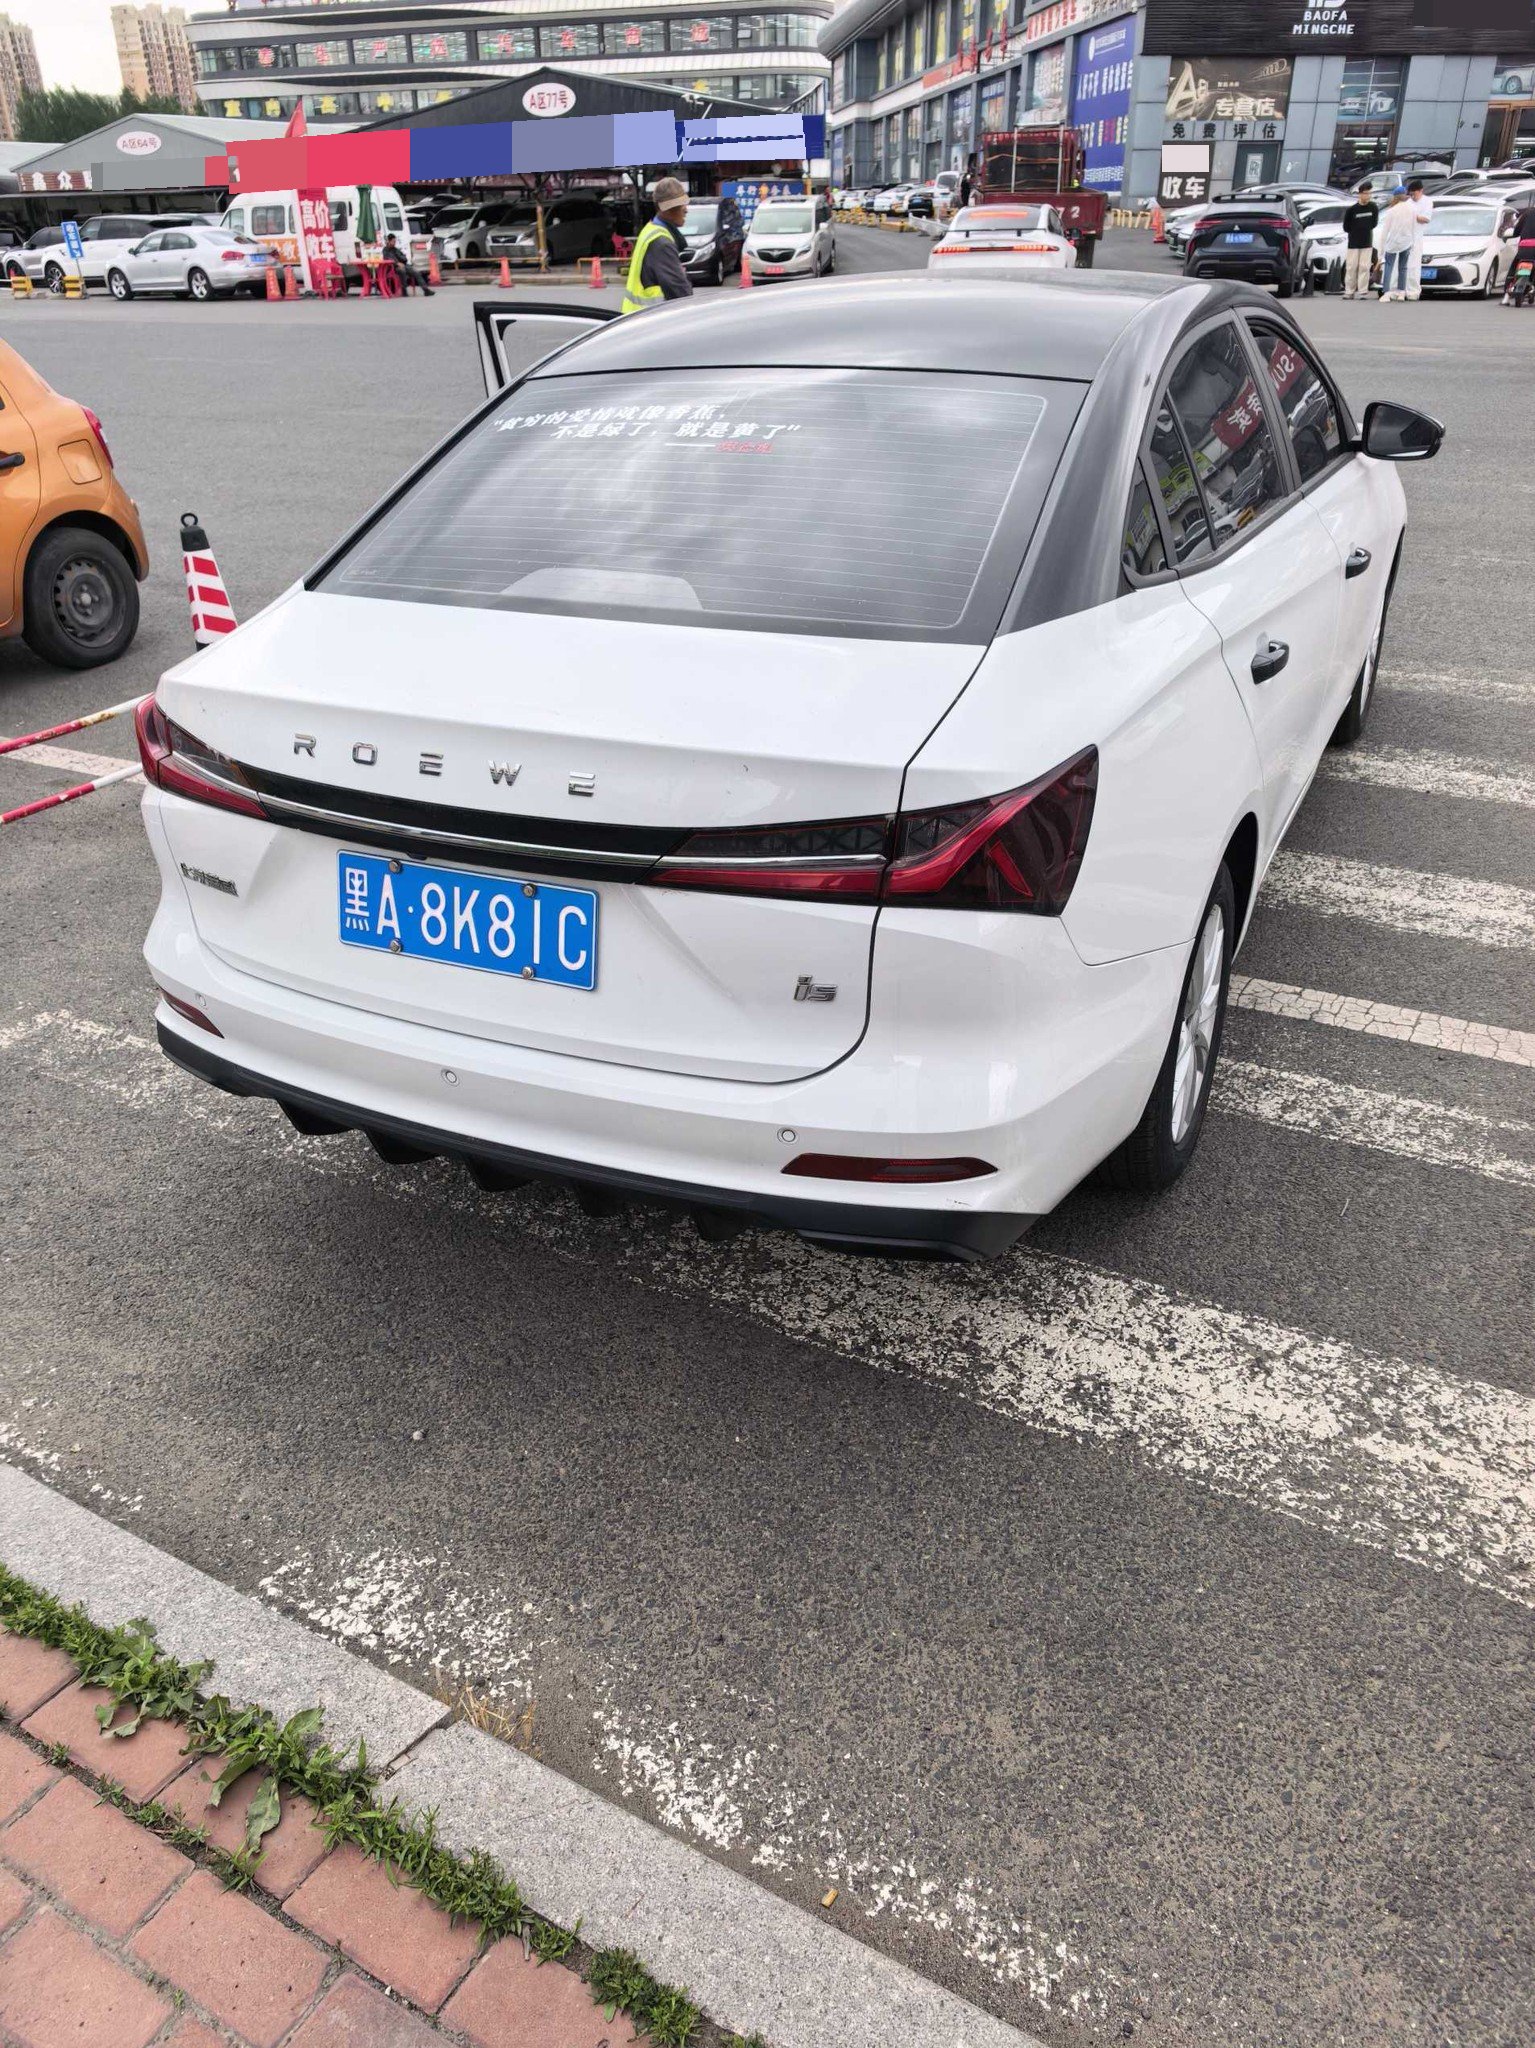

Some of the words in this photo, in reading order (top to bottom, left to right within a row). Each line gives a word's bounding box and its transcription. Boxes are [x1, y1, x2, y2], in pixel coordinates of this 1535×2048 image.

[1303, 10, 1348, 21] BAOFA
[1292, 24, 1355, 35] MINGCHE
[1215, 98, 1276, 117] 专营店
[1172, 122, 1277, 139] 免费评估
[1161, 176, 1206, 200] 收车
[293, 732, 597, 798] ROEWE
